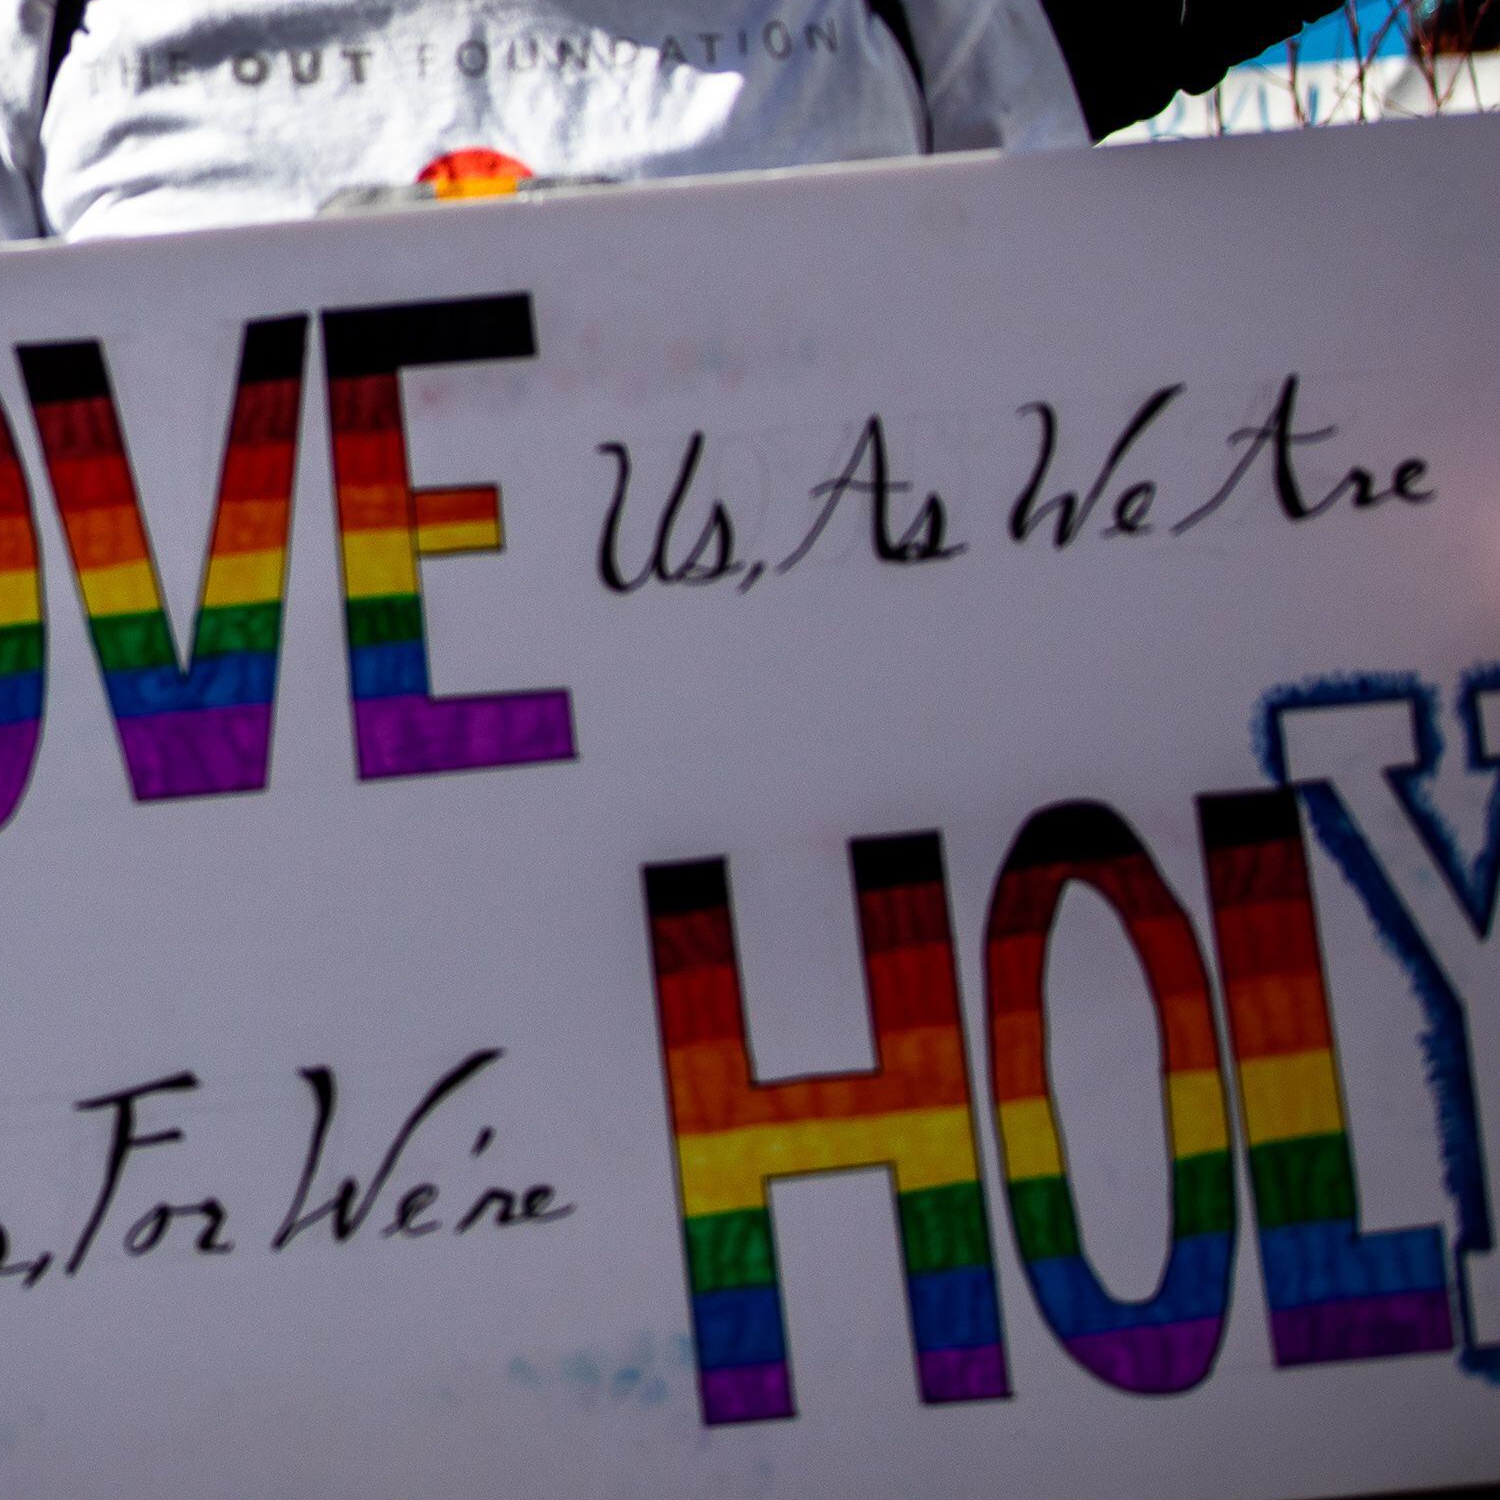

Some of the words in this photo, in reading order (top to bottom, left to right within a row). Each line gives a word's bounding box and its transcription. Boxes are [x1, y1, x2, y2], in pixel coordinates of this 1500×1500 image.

[230, 47, 373, 87] OUT
[416, 15, 842, 79] FOUNDATION
[779, 413, 967, 575] As
[1008, 382, 1186, 550] We
[1171, 372, 1438, 535] Are
[64, 1070, 236, 1278] For
[270, 1047, 577, 1255] We're
